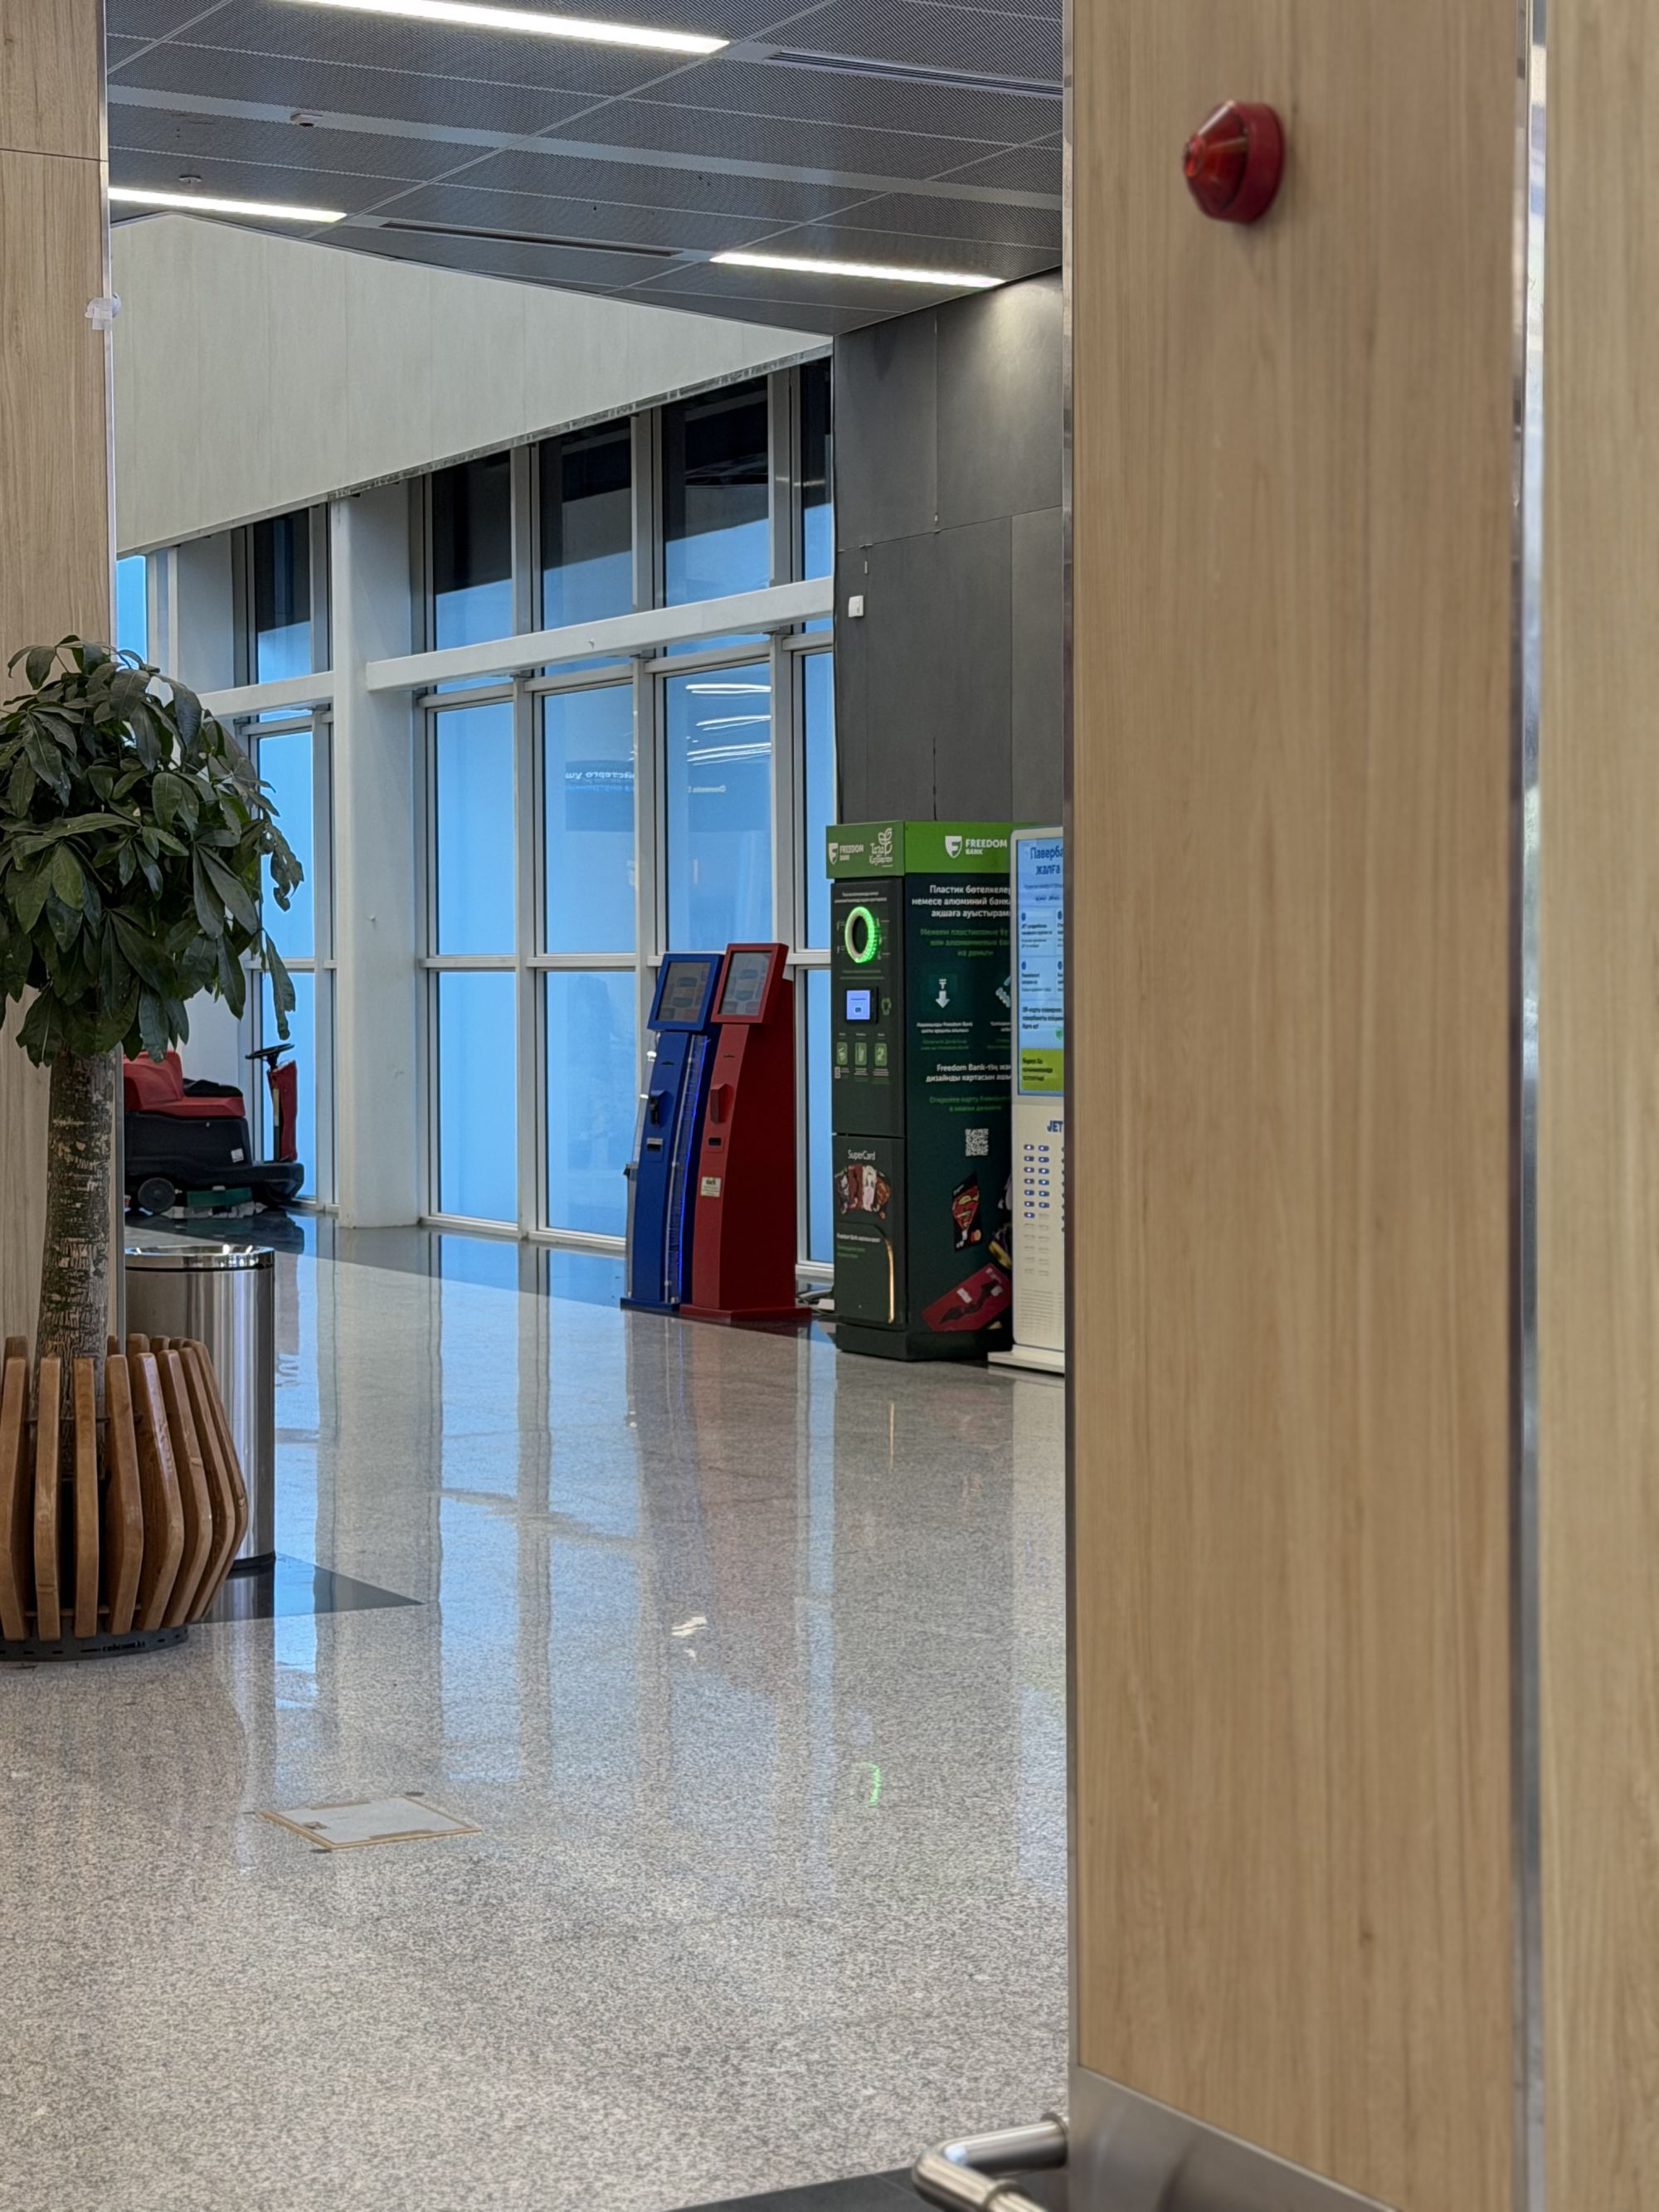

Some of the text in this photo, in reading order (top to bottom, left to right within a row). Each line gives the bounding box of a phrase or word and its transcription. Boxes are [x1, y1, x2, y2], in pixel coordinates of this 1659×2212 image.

[965, 839, 1008, 848] FREEDOM
[929, 884, 964, 894] Пластик
[912, 897, 943, 906] немесе
[944, 897, 988, 906] алюминий
[937, 1063, 967, 1072] Freedom
[1047, 1120, 1063, 1133] JET
